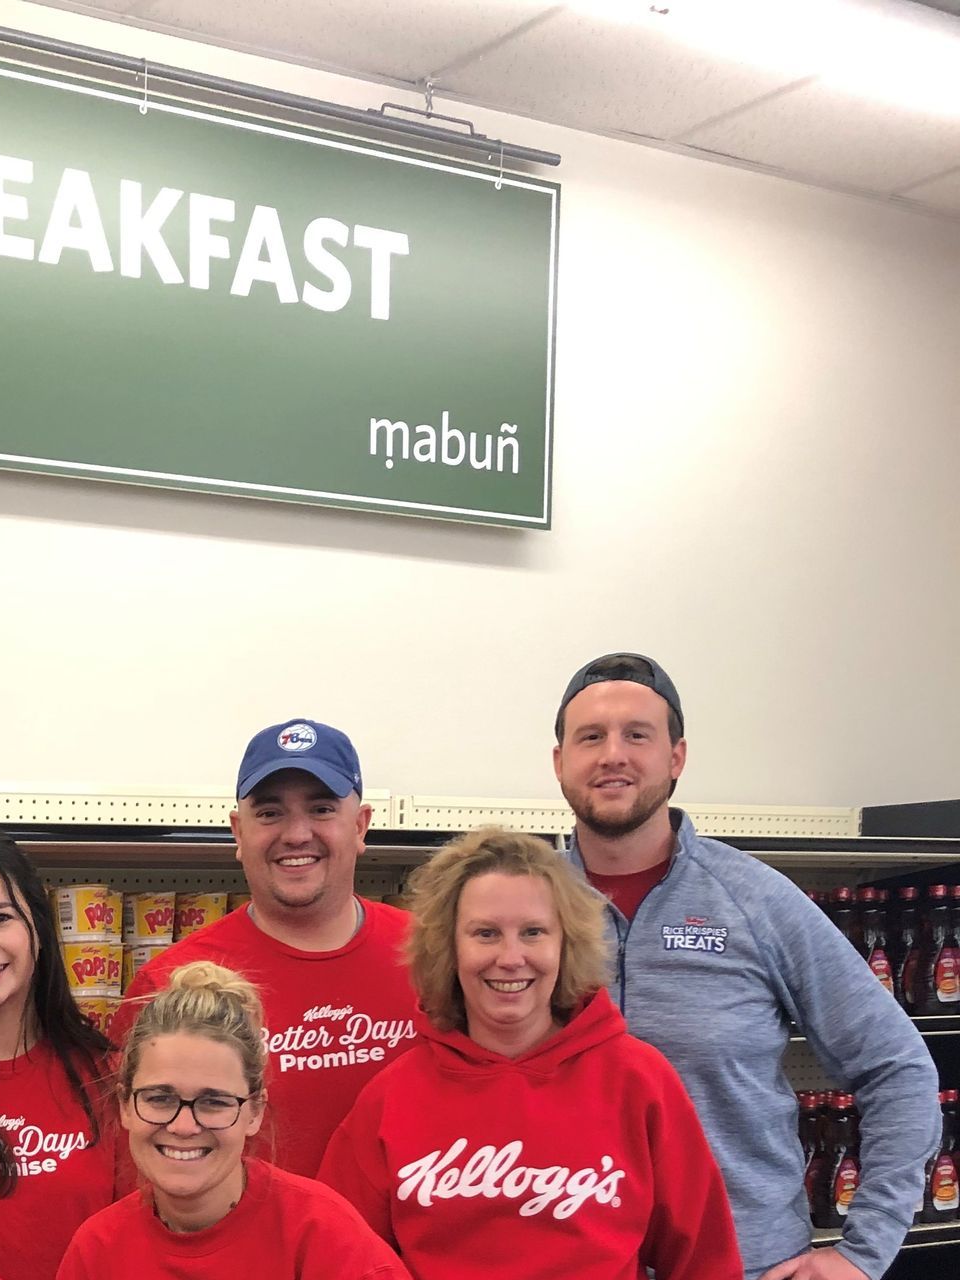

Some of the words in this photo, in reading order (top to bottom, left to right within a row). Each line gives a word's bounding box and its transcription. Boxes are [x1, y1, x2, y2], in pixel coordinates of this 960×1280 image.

[662, 926, 684, 935] RICE
[685, 925, 727, 937] KRISPIES
[663, 935, 725, 952] TREATS
[303, 1004, 353, 1022] Kellogg's
[339, 1013, 417, 1048] Days
[279, 1045, 385, 1072] Promise
[13, 1125, 89, 1159] Days
[397, 1138, 625, 1219] Kellogg's
